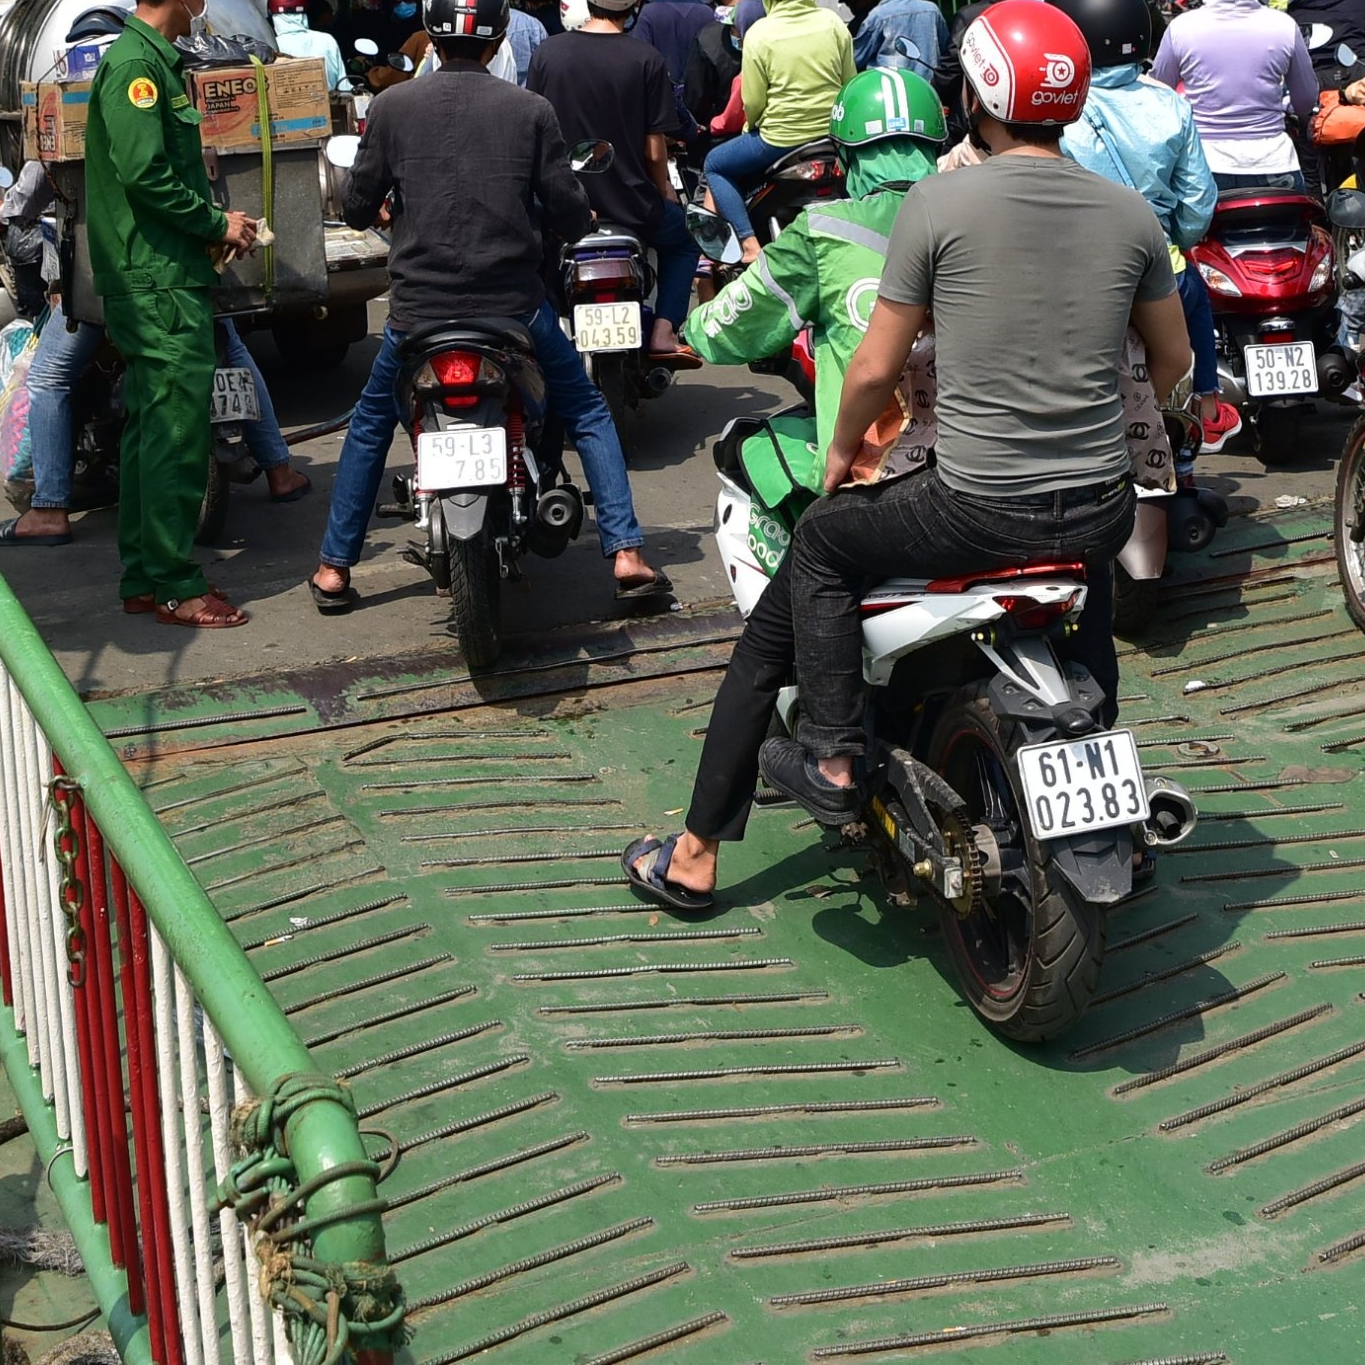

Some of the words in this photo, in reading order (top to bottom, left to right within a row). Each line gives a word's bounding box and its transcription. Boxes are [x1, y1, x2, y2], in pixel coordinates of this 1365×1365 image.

[203, 75, 270, 99] ENEO
[1031, 90, 1078, 106] goviet
[207, 101, 232, 110] JAPAN
[831, 101, 845, 121] ab
[585, 306, 630, 326] 59-L2
[580, 326, 637, 348] 043.59
[1255, 346, 1305, 369] 50-N2
[1255, 368, 1312, 392] 139.28
[432, 433, 493, 457] 59-L3
[749, 502, 791, 546] Grab
[747, 533, 786, 568] ood
[1038, 739, 1120, 788] 61-N1
[1035, 778, 1141, 832] 023.83
